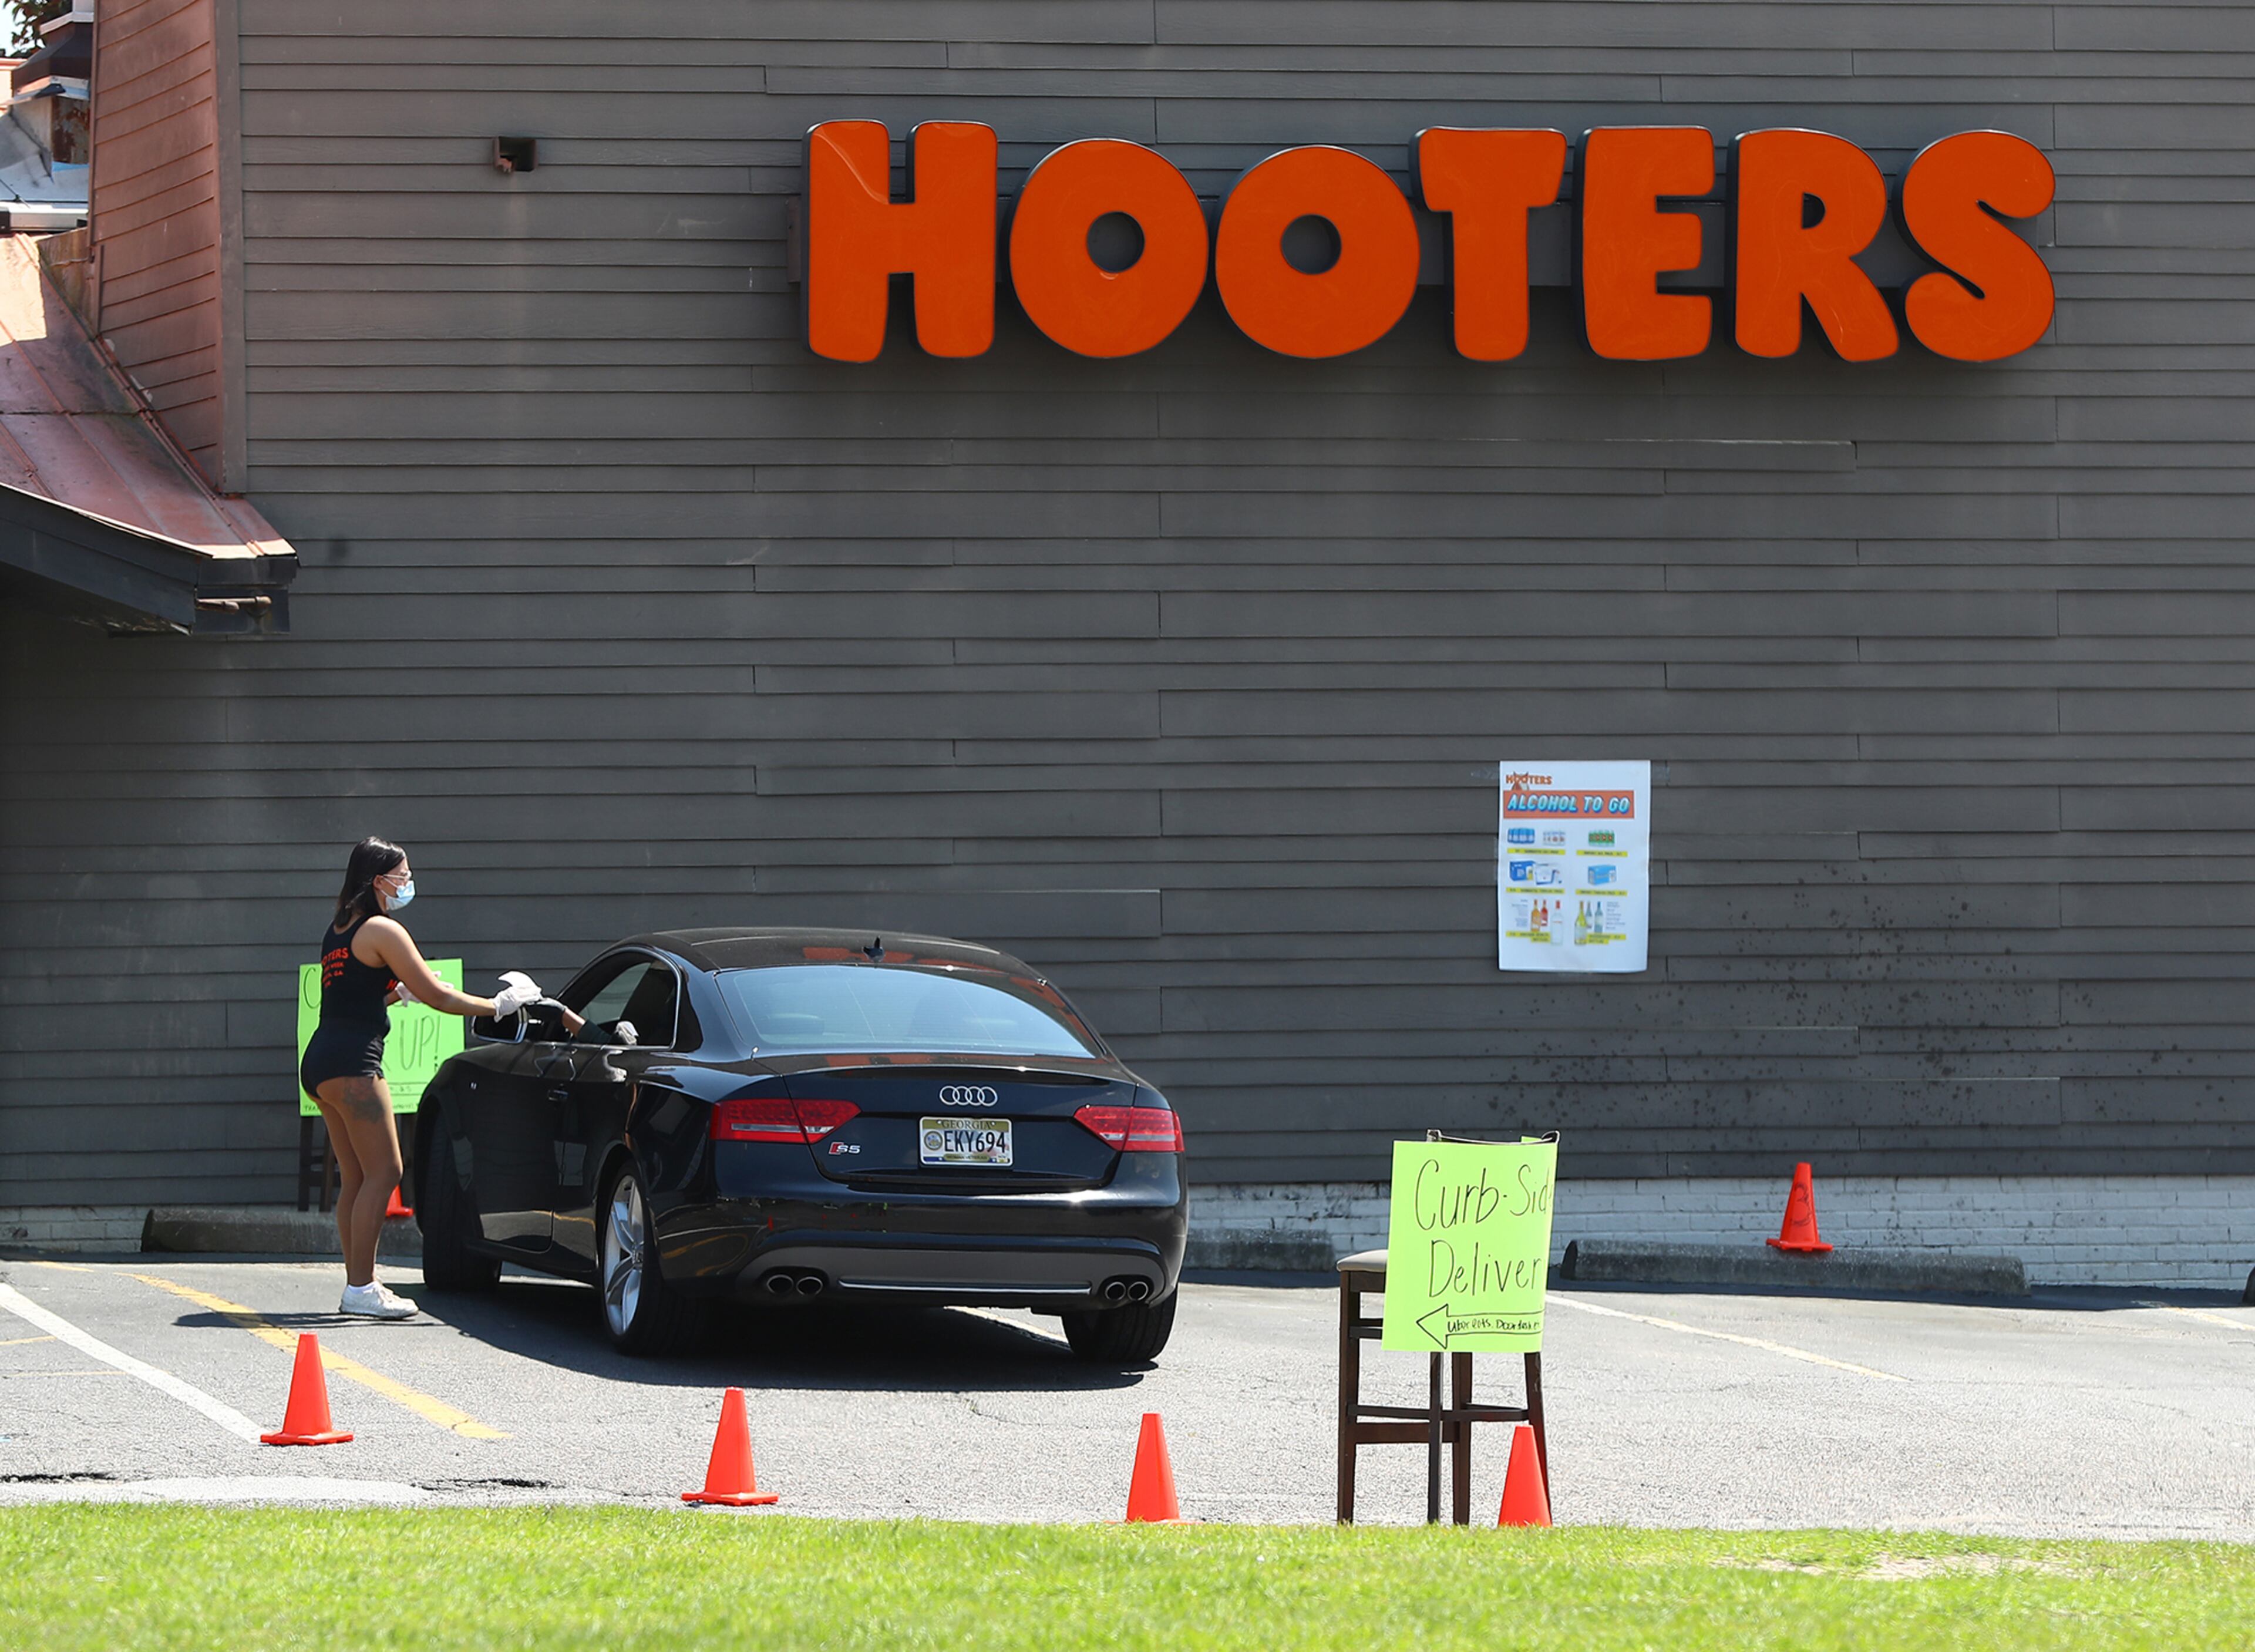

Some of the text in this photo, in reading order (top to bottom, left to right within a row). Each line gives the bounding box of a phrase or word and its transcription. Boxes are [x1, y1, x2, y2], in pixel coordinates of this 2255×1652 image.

[806, 119, 2057, 363] HOOTERS
[1506, 773, 1552, 785] HOOTERS
[1507, 794, 1630, 814] ALCOHOL TO GO
[399, 1015, 440, 1072] UP!
[941, 1119, 992, 1130] GEORGIA
[836, 1144, 861, 1154] S5
[944, 1131, 1006, 1153] EKY694
[1429, 1240, 1544, 1297] Deliver
